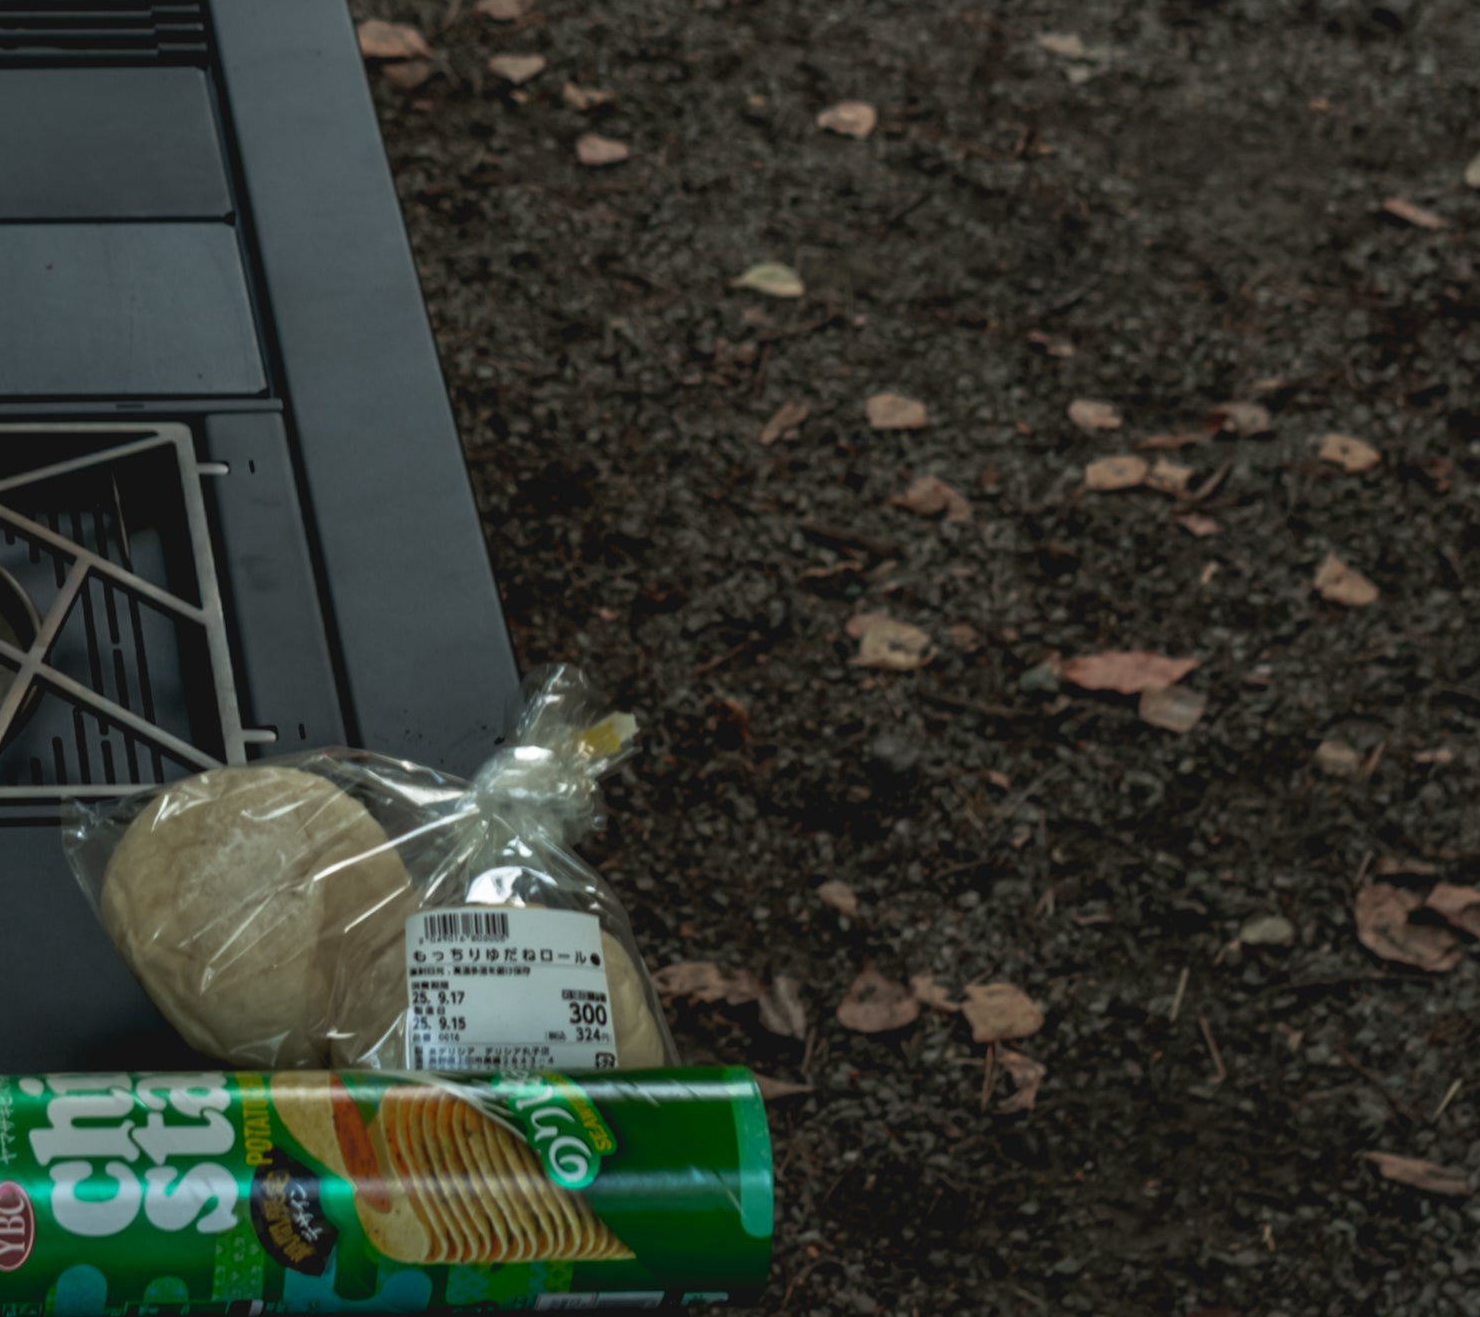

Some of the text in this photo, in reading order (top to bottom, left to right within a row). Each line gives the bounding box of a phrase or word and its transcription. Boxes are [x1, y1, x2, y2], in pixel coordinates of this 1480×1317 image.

[413, 947, 587, 965] もっちりゆだねロール
[438, 991, 465, 1005] 9.17
[569, 1002, 608, 1026] 300
[439, 1017, 466, 1030] 9.15
